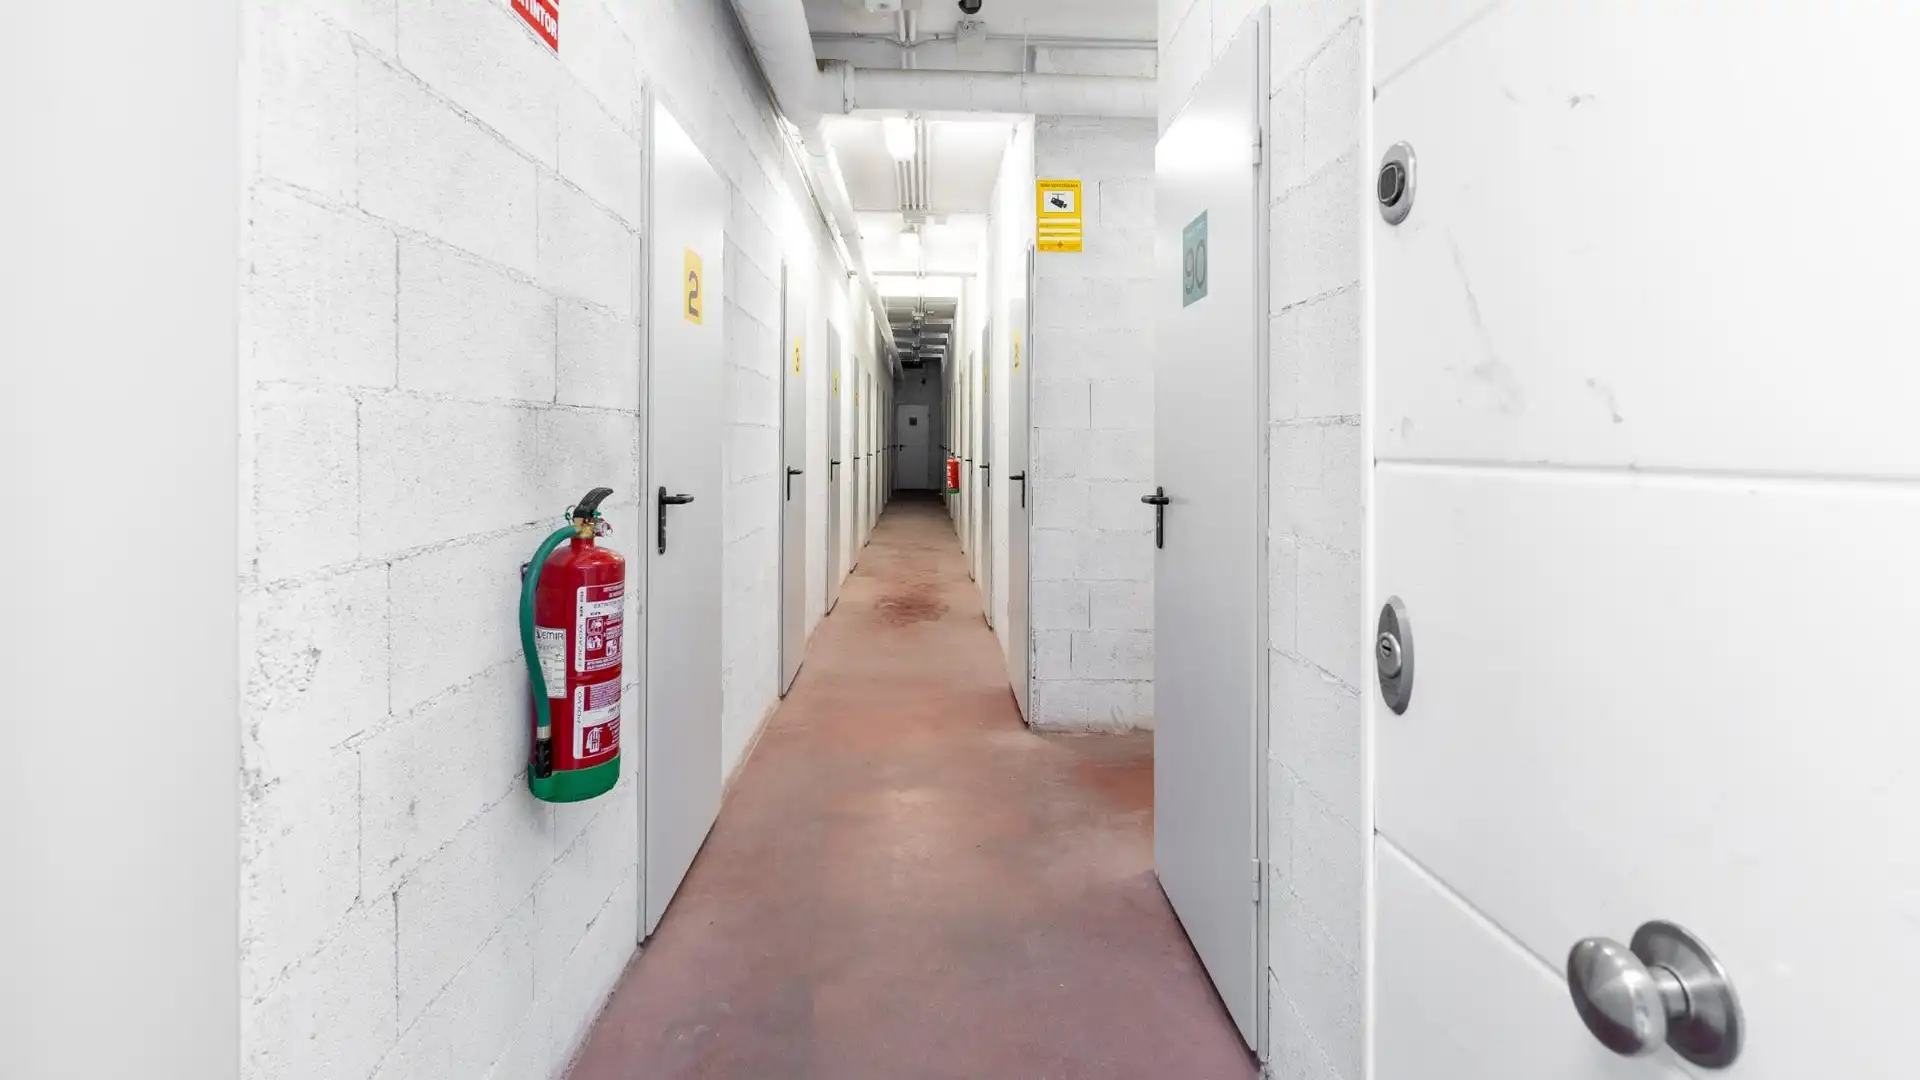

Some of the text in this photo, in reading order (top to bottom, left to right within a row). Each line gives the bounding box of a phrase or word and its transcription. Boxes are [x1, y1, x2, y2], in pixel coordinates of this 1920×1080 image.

[517, 0, 557, 40] TINTOR
[1185, 239, 1206, 296] 90
[688, 270, 699, 317] 2
